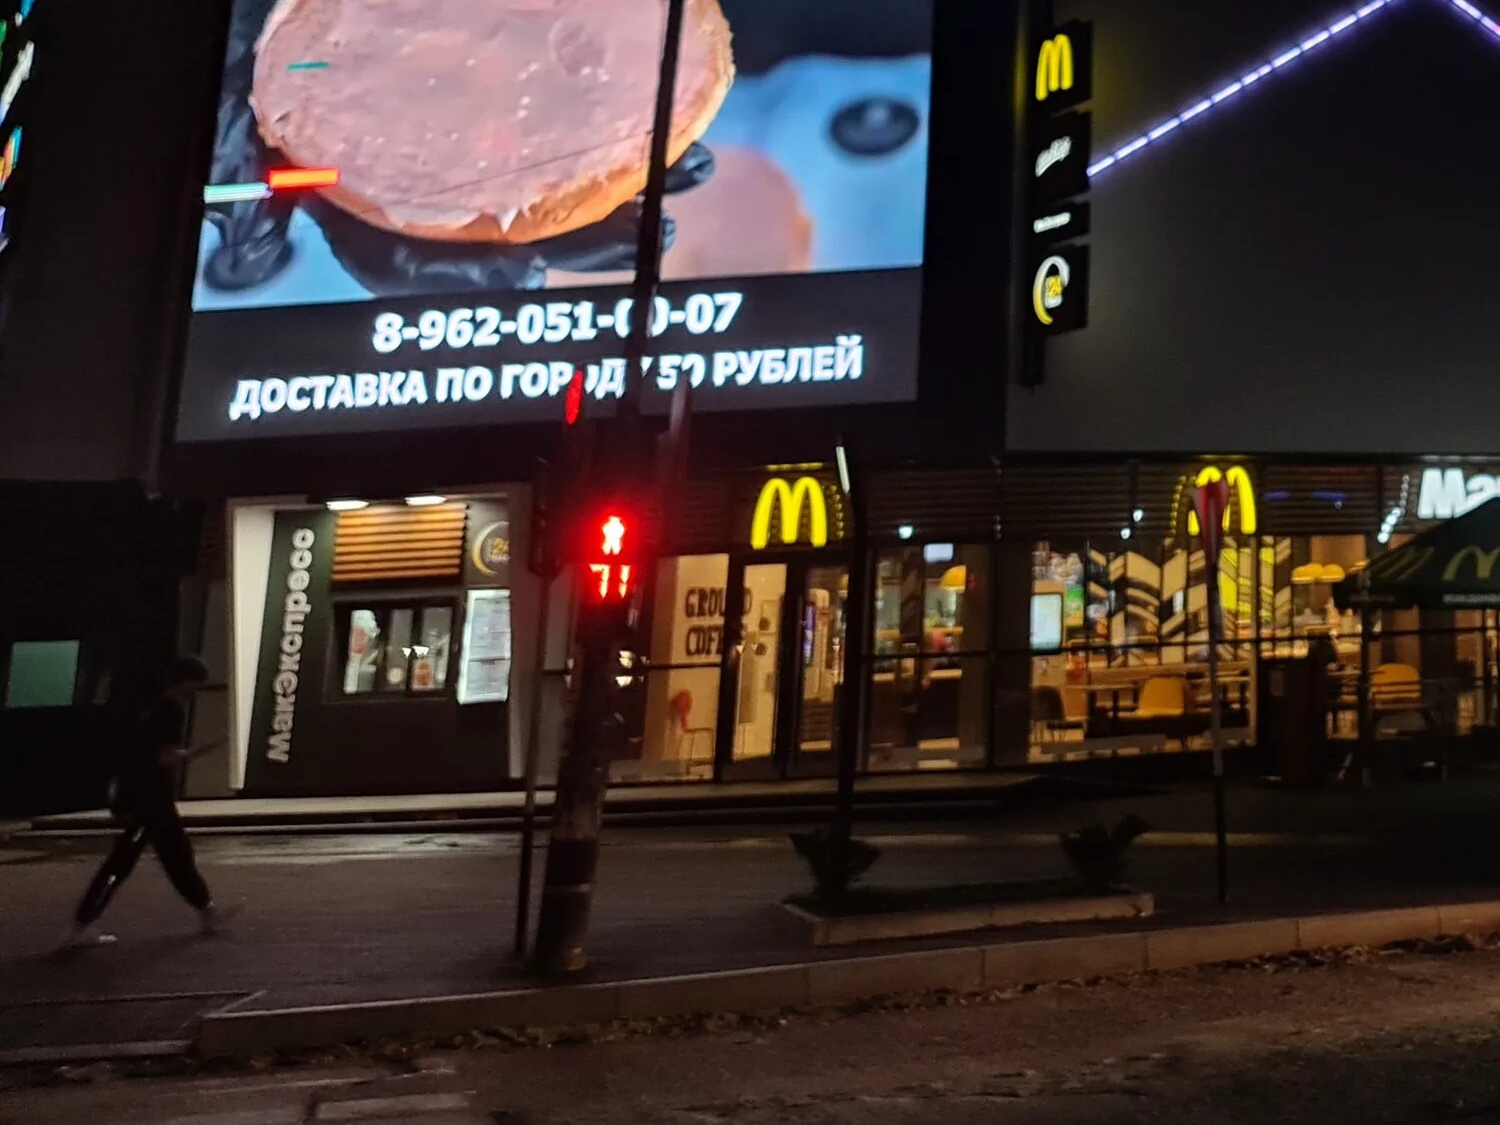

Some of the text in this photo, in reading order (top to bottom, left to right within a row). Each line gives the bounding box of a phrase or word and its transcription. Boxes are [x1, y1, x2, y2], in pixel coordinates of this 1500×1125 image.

[229, 370, 428, 421] ДОСТАВКА
[435, 365, 493, 403] ПО
[711, 334, 863, 387] РУБЛЕЙ
[685, 586, 753, 618] GROUD
